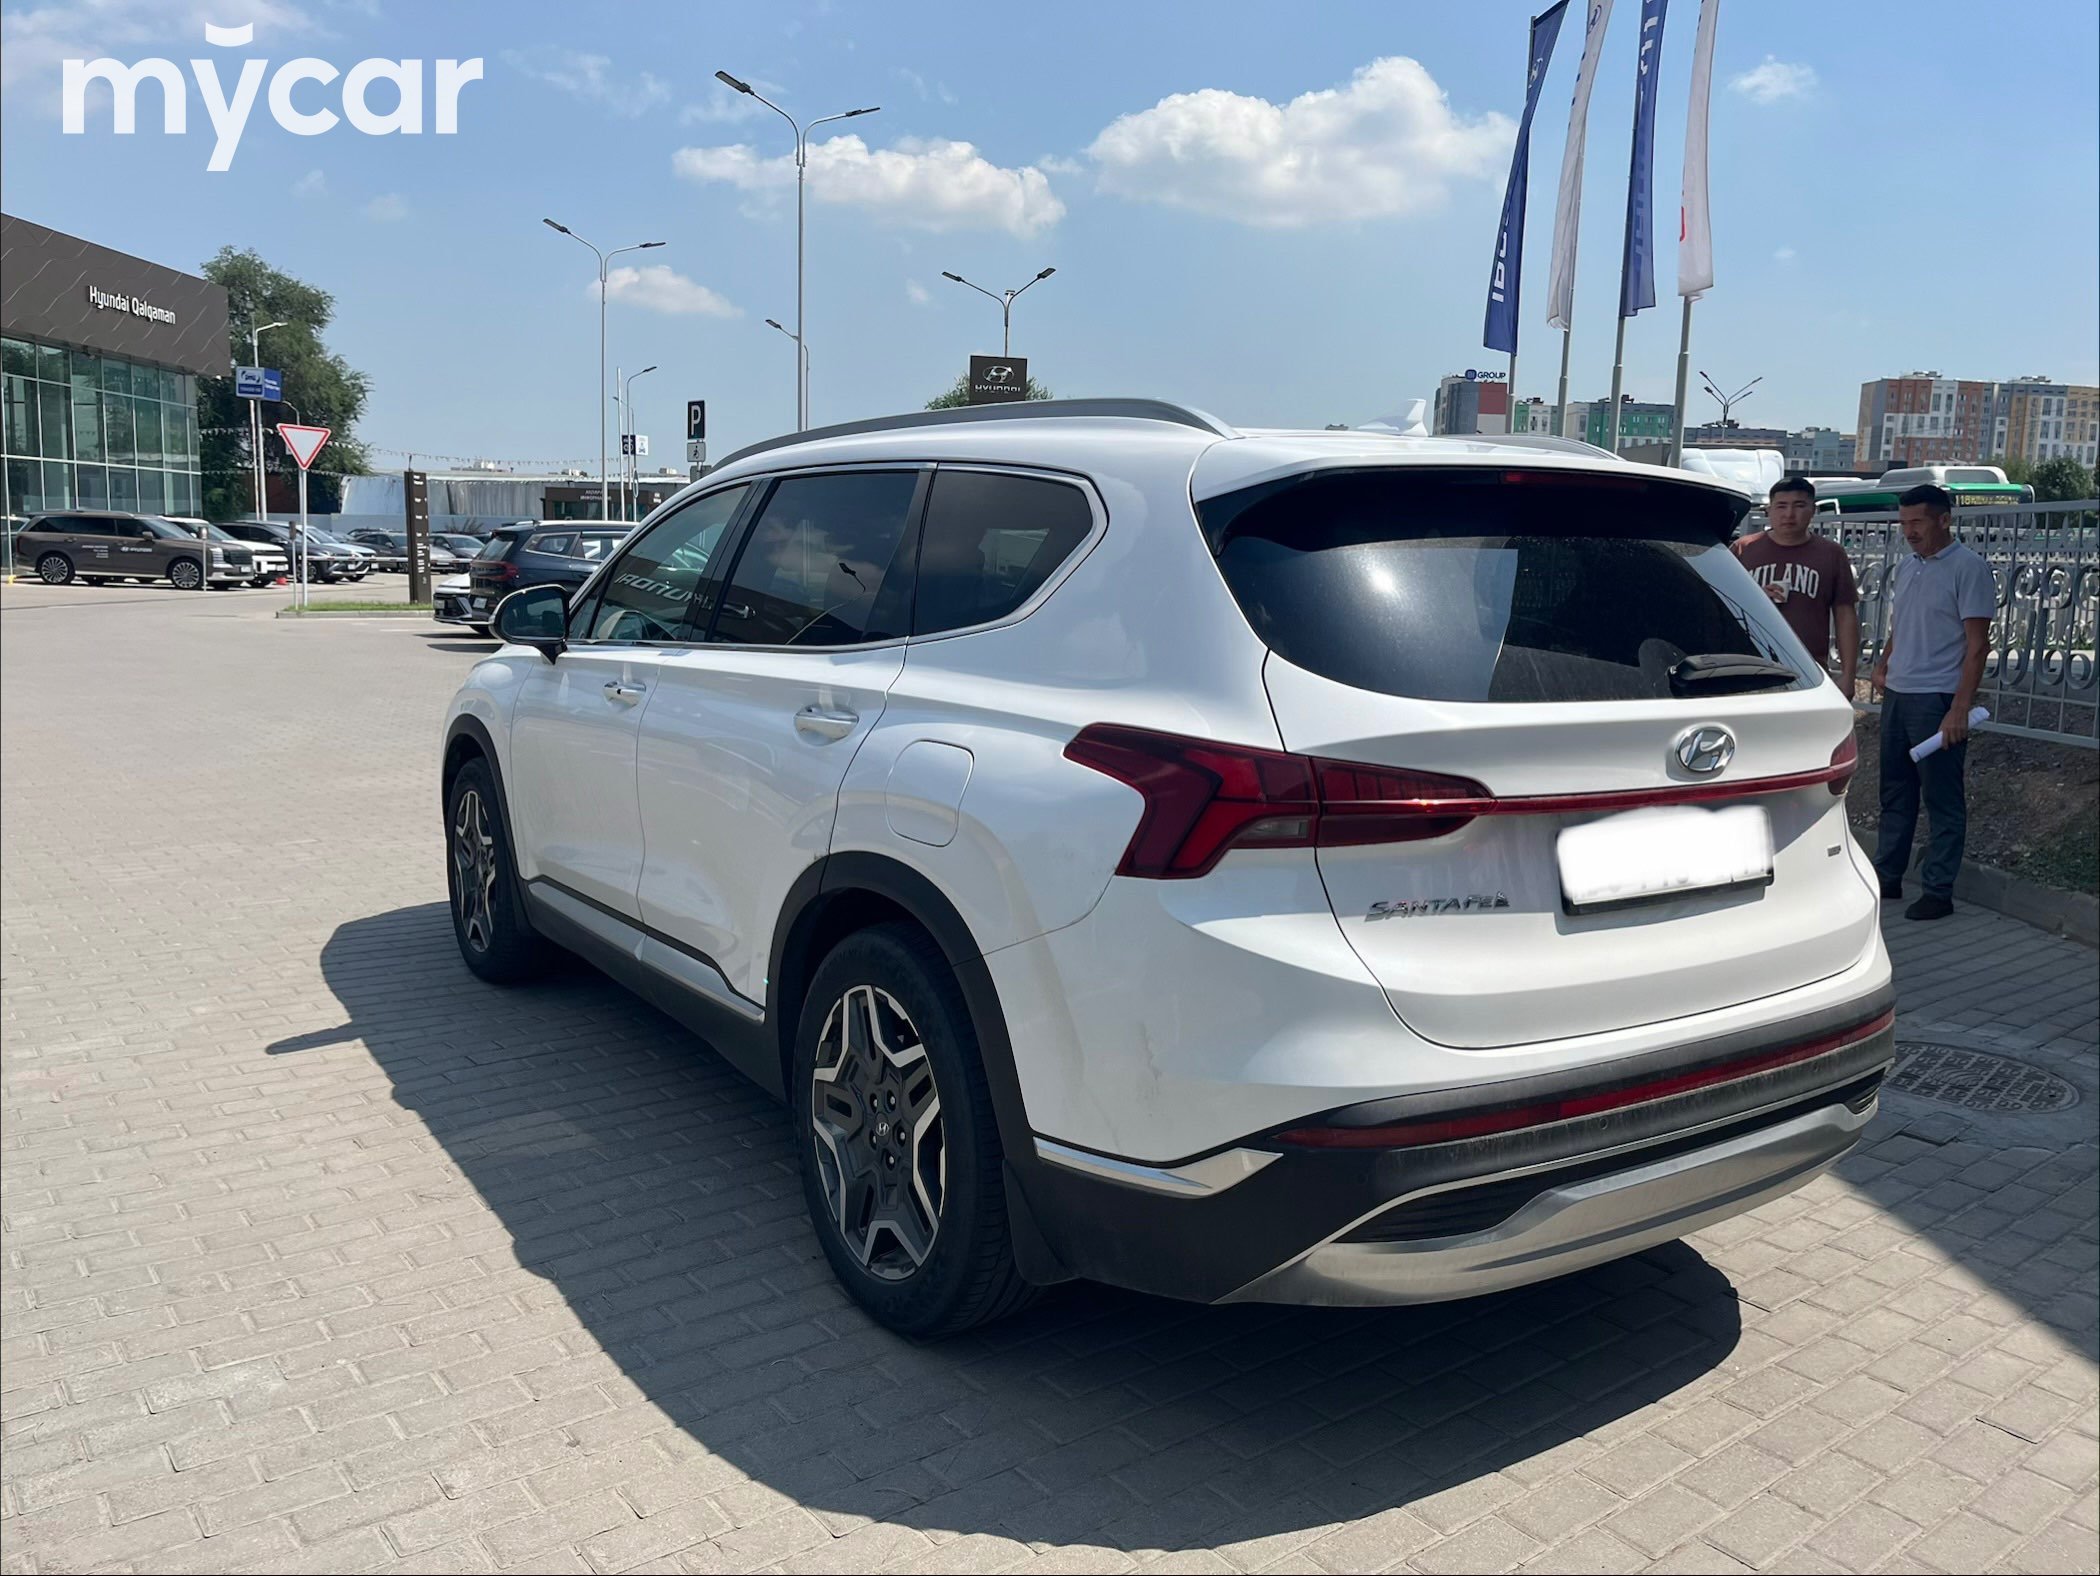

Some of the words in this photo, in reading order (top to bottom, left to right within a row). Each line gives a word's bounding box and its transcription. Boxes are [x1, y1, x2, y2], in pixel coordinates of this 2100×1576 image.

[89, 285, 130, 312] Hyundai
[131, 297, 176, 324] Qalqaman
[1477, 371, 1506, 379] GROUP
[691, 405, 701, 435] P
[1748, 563, 1820, 599] MILANO
